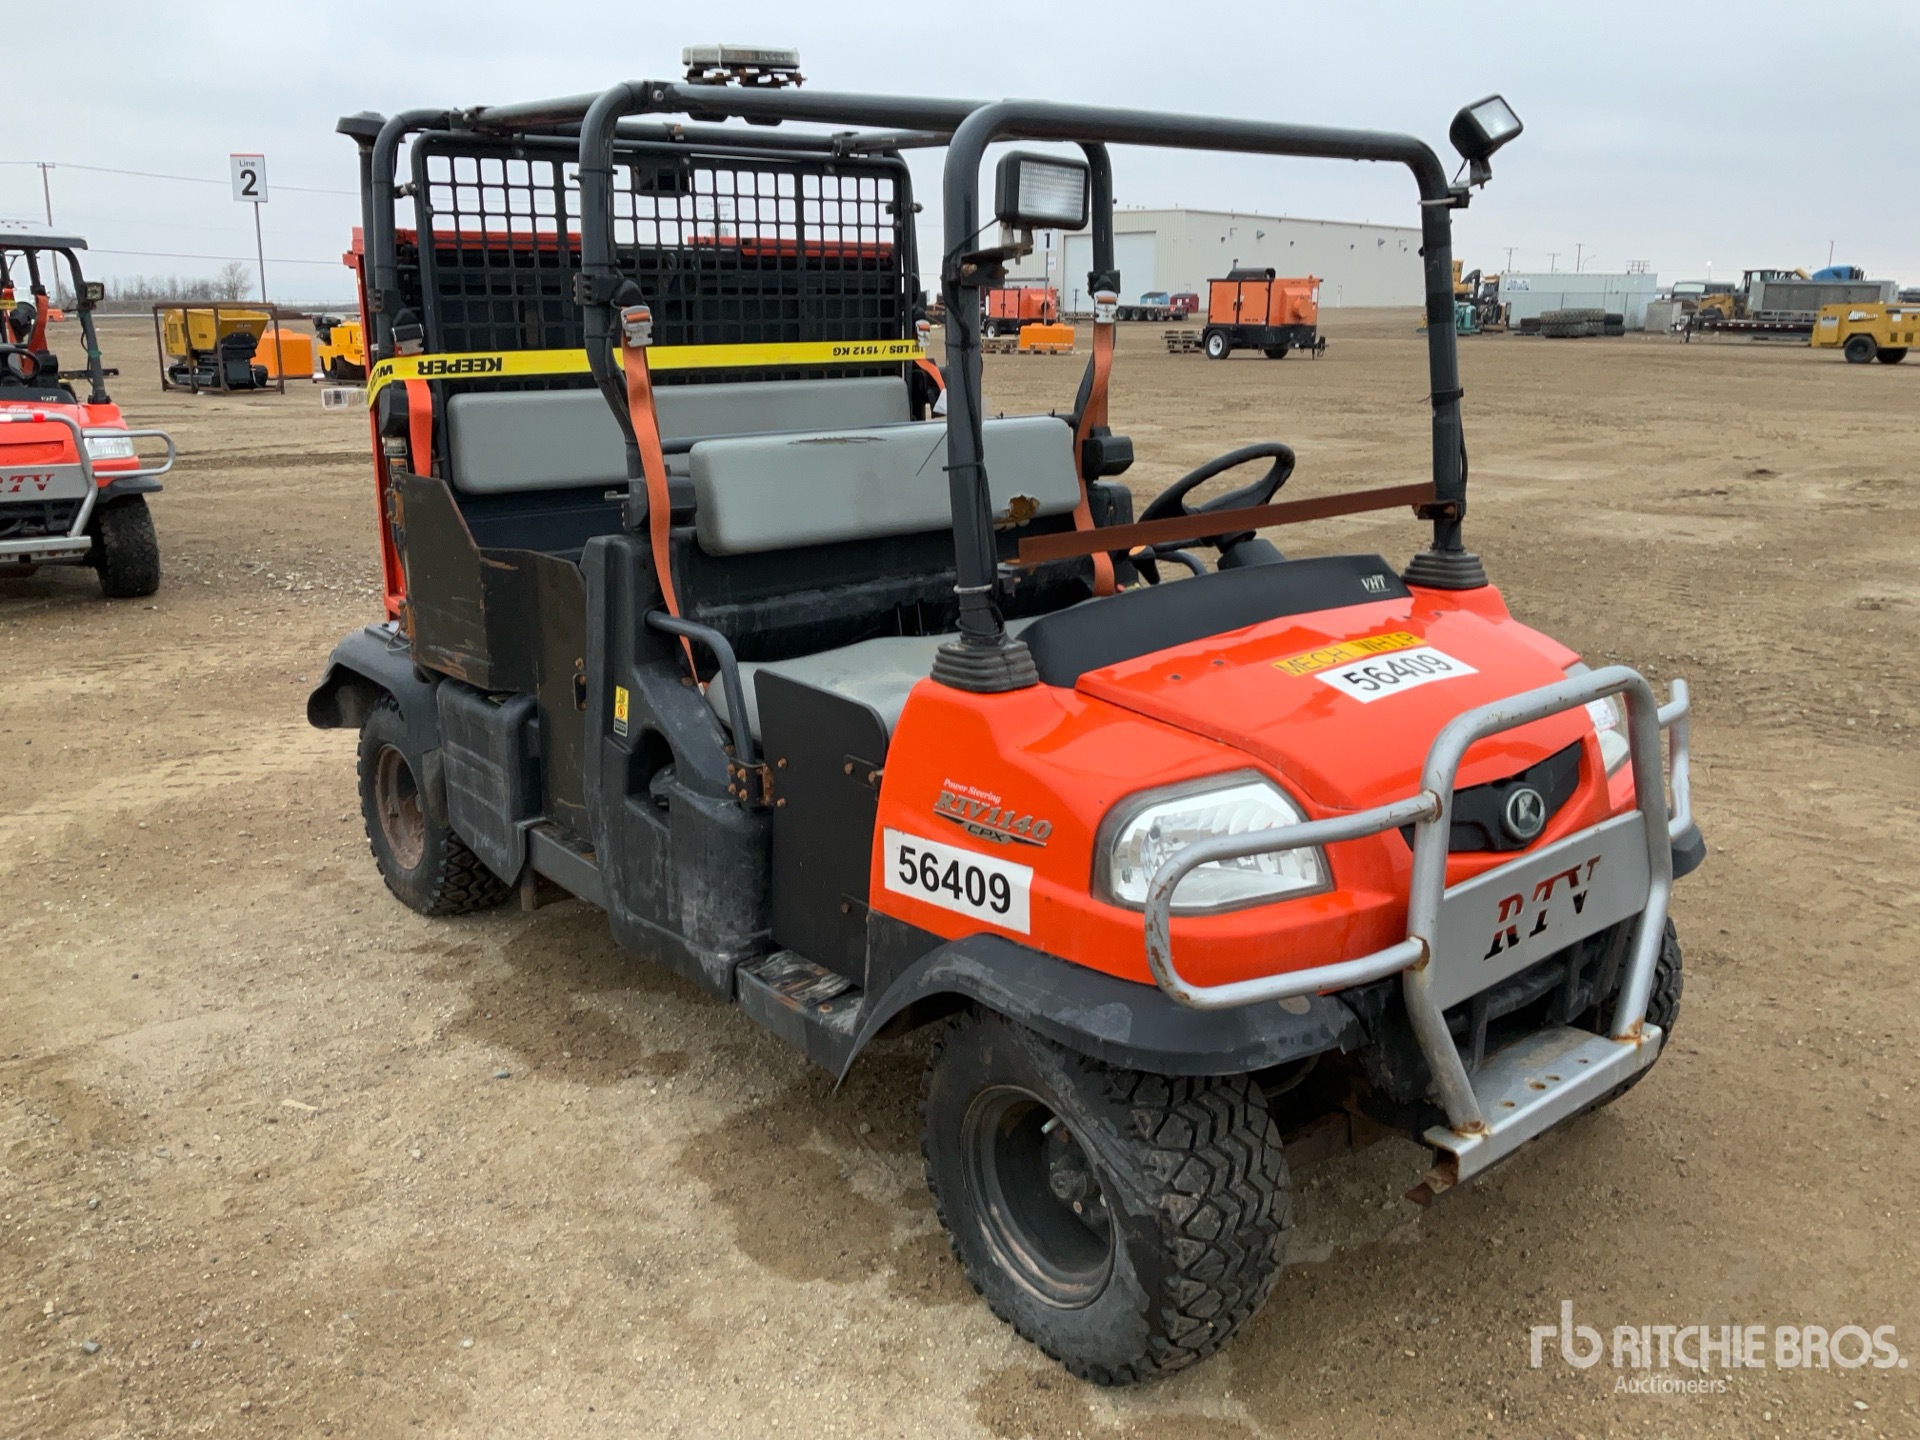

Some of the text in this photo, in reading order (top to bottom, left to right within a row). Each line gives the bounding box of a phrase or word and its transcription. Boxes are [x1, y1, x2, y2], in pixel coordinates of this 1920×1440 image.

[239, 159, 256, 167] Line
[240, 169, 259, 196] 2
[1044, 233, 1051, 249] 1
[832, 347, 850, 356] KG
[853, 346, 878, 355] 1512
[889, 345, 909, 354] LBS
[417, 357, 503, 376] KEEPER
[1361, 574, 1385, 592] VHT
[1274, 633, 1414, 676] MECH WHIP
[1343, 654, 1453, 691] 56409
[944, 778, 1001, 805] Power Steering
[936, 790, 1052, 839] RTV1140
[968, 825, 1004, 841] CPX
[899, 845, 1011, 914] 56409
[1484, 855, 1602, 960] RTV
